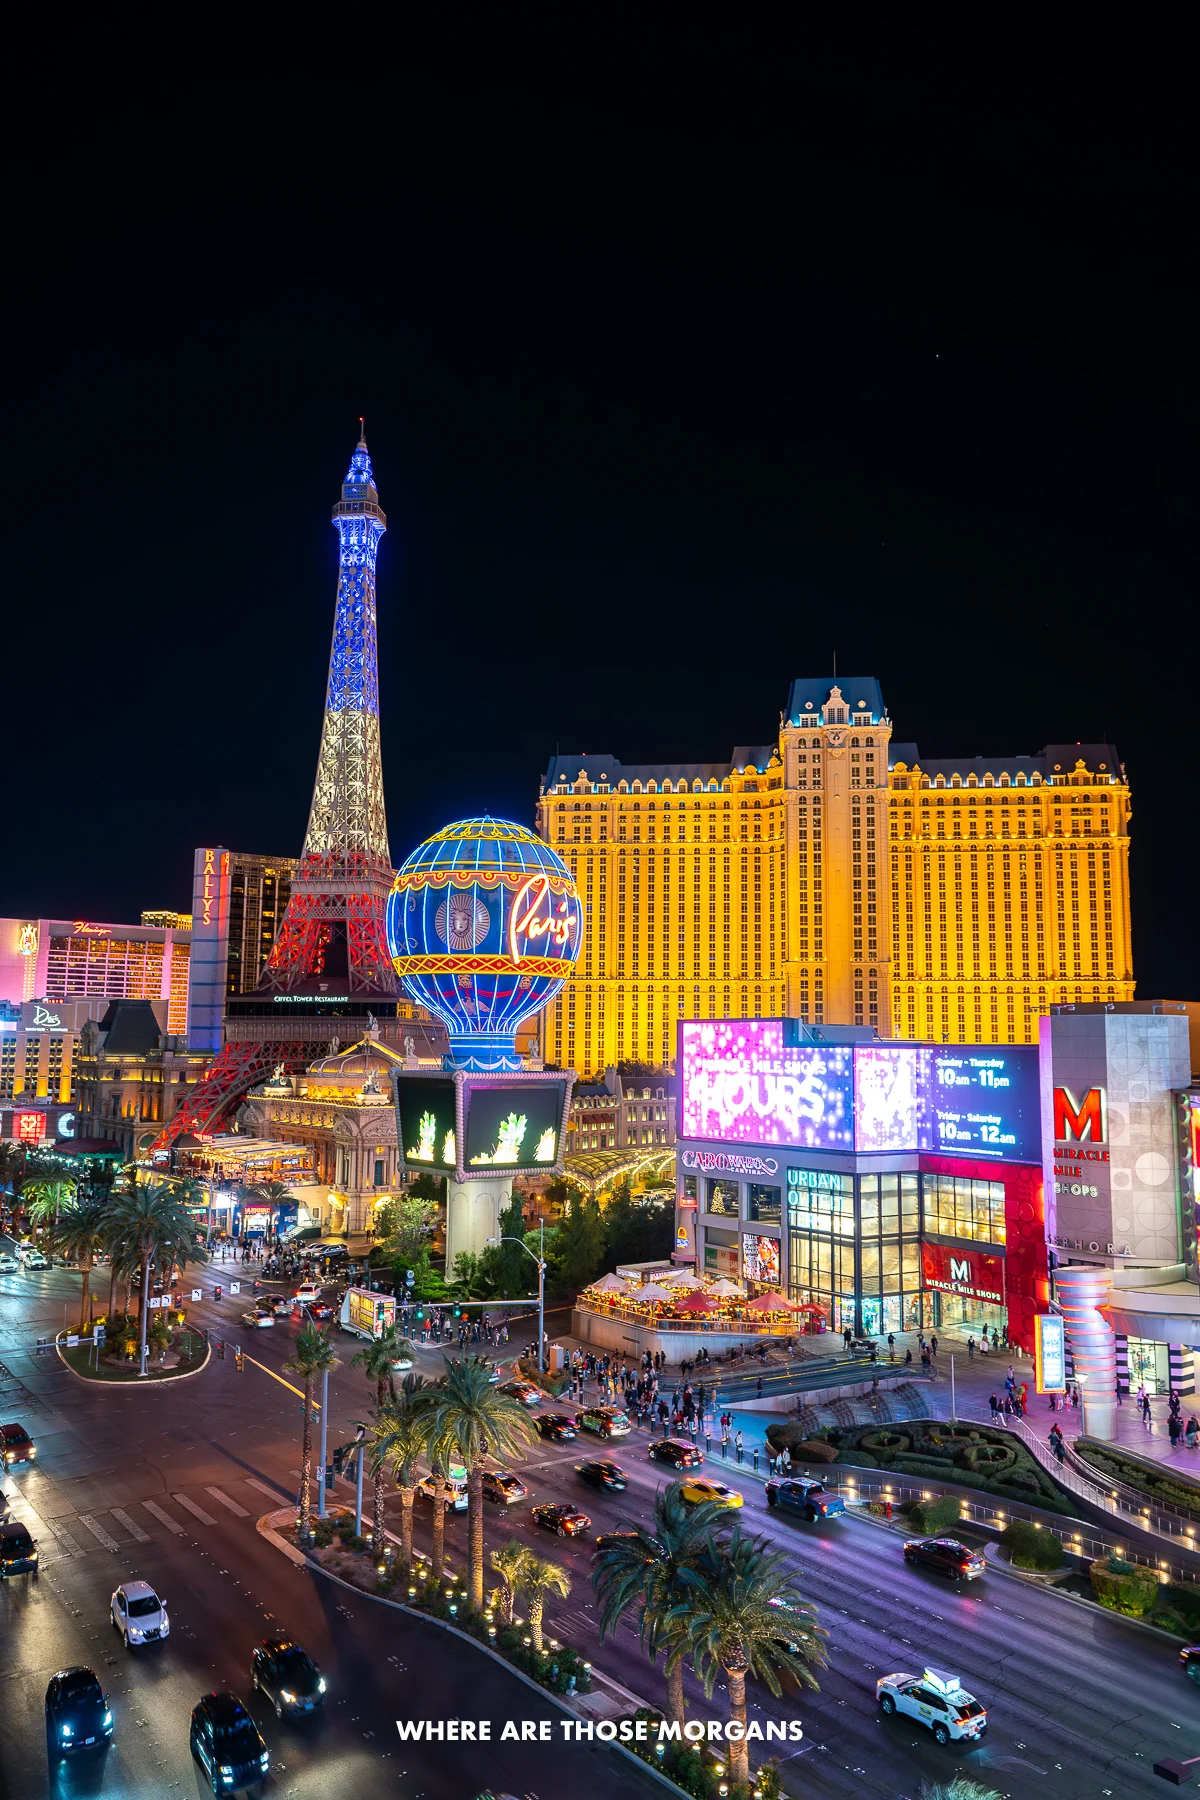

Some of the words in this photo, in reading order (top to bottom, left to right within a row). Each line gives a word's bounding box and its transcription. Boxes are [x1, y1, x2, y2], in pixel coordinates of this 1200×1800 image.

[202, 849, 215, 925] BALLYS
[73, 921, 112, 936] Flamingo
[510, 873, 577, 964] Paris
[784, 1060, 827, 1075] SHOPS
[936, 1057, 963, 1069] Sunday
[969, 1058, 1004, 1069] Thursday
[936, 1068, 970, 1086] 10am
[979, 1069, 1010, 1088] 11pm
[700, 1072, 825, 1122] HOURS
[937, 1112, 960, 1123] Friday
[967, 1113, 1001, 1125] Saturday
[1053, 1086, 1106, 1143] M
[938, 1122, 971, 1140] 10am
[980, 1125, 1016, 1144] 12am
[681, 1150, 728, 1172] CABO
[727, 1154, 771, 1172] WABO
[1053, 1147, 1110, 1162] MIRACLE
[731, 1167, 763, 1176] CANTINA
[788, 1169, 841, 1190] URBAN
[1053, 1164, 1082, 1178] MILE
[1053, 1181, 1098, 1198] SHOPS
[788, 1190, 843, 1212] OUTFIT
[1047, 1233, 1132, 1254] SEPHORA
[950, 1257, 969, 1283] M
[926, 1278, 957, 1291] MIRACLE
[957, 1283, 975, 1295] MILE
[976, 1289, 1001, 1301] SHOPS
